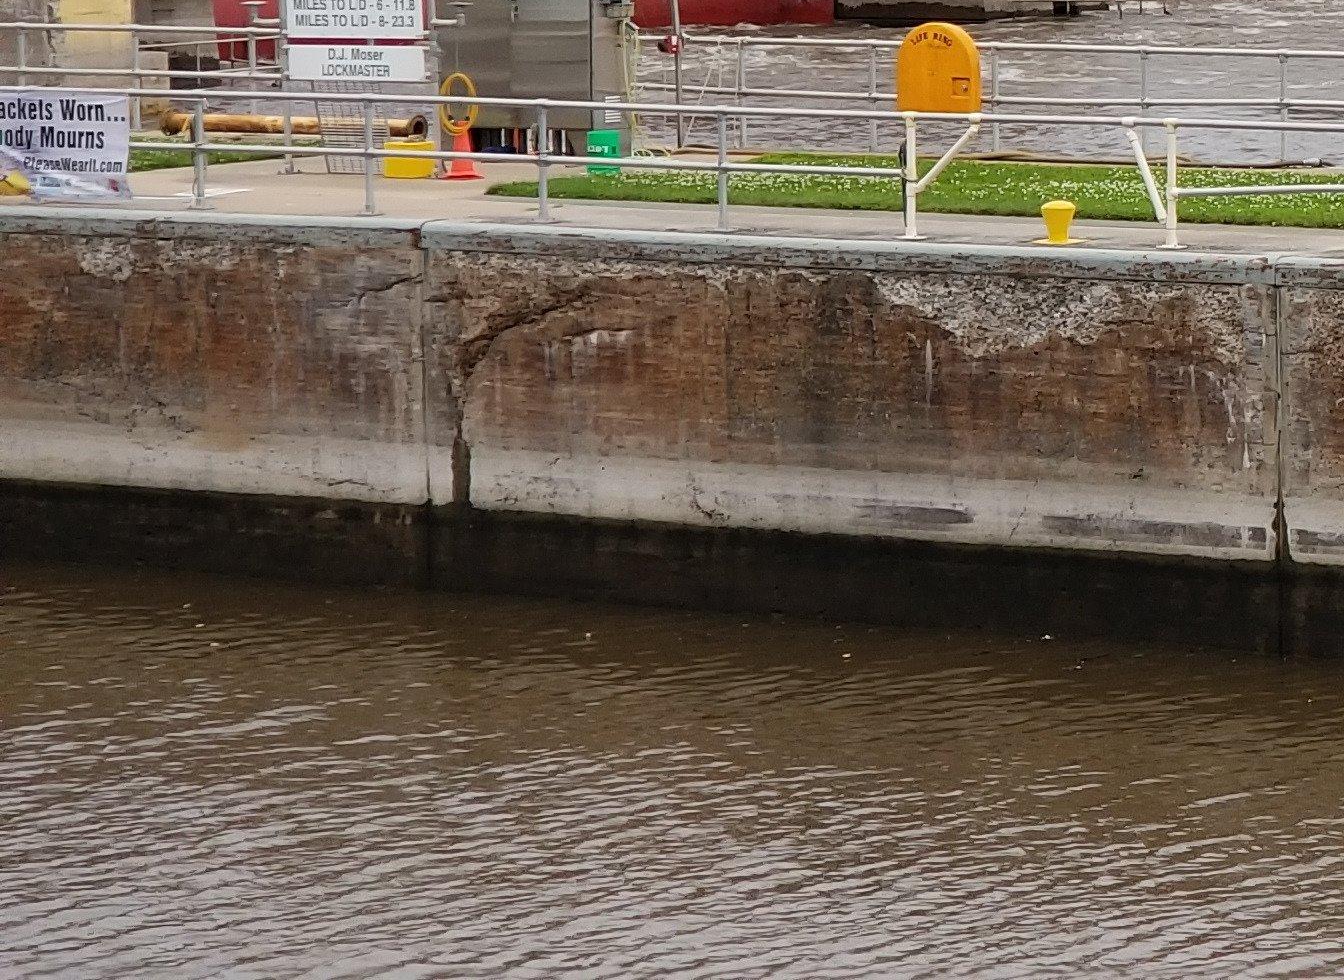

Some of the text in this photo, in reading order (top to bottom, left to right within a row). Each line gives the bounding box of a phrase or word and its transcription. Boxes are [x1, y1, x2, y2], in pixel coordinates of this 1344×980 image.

[393, 0, 416, 11] 11.8
[295, 14, 329, 27] MILES
[332, 14, 347, 27] TO
[391, 15, 415, 28] 23.3
[327, 48, 384, 61] D.J. Moser
[321, 64, 391, 78] LOCKMASTER
[59, 98, 126, 122] Worn...
[40, 125, 105, 150] Mourns
